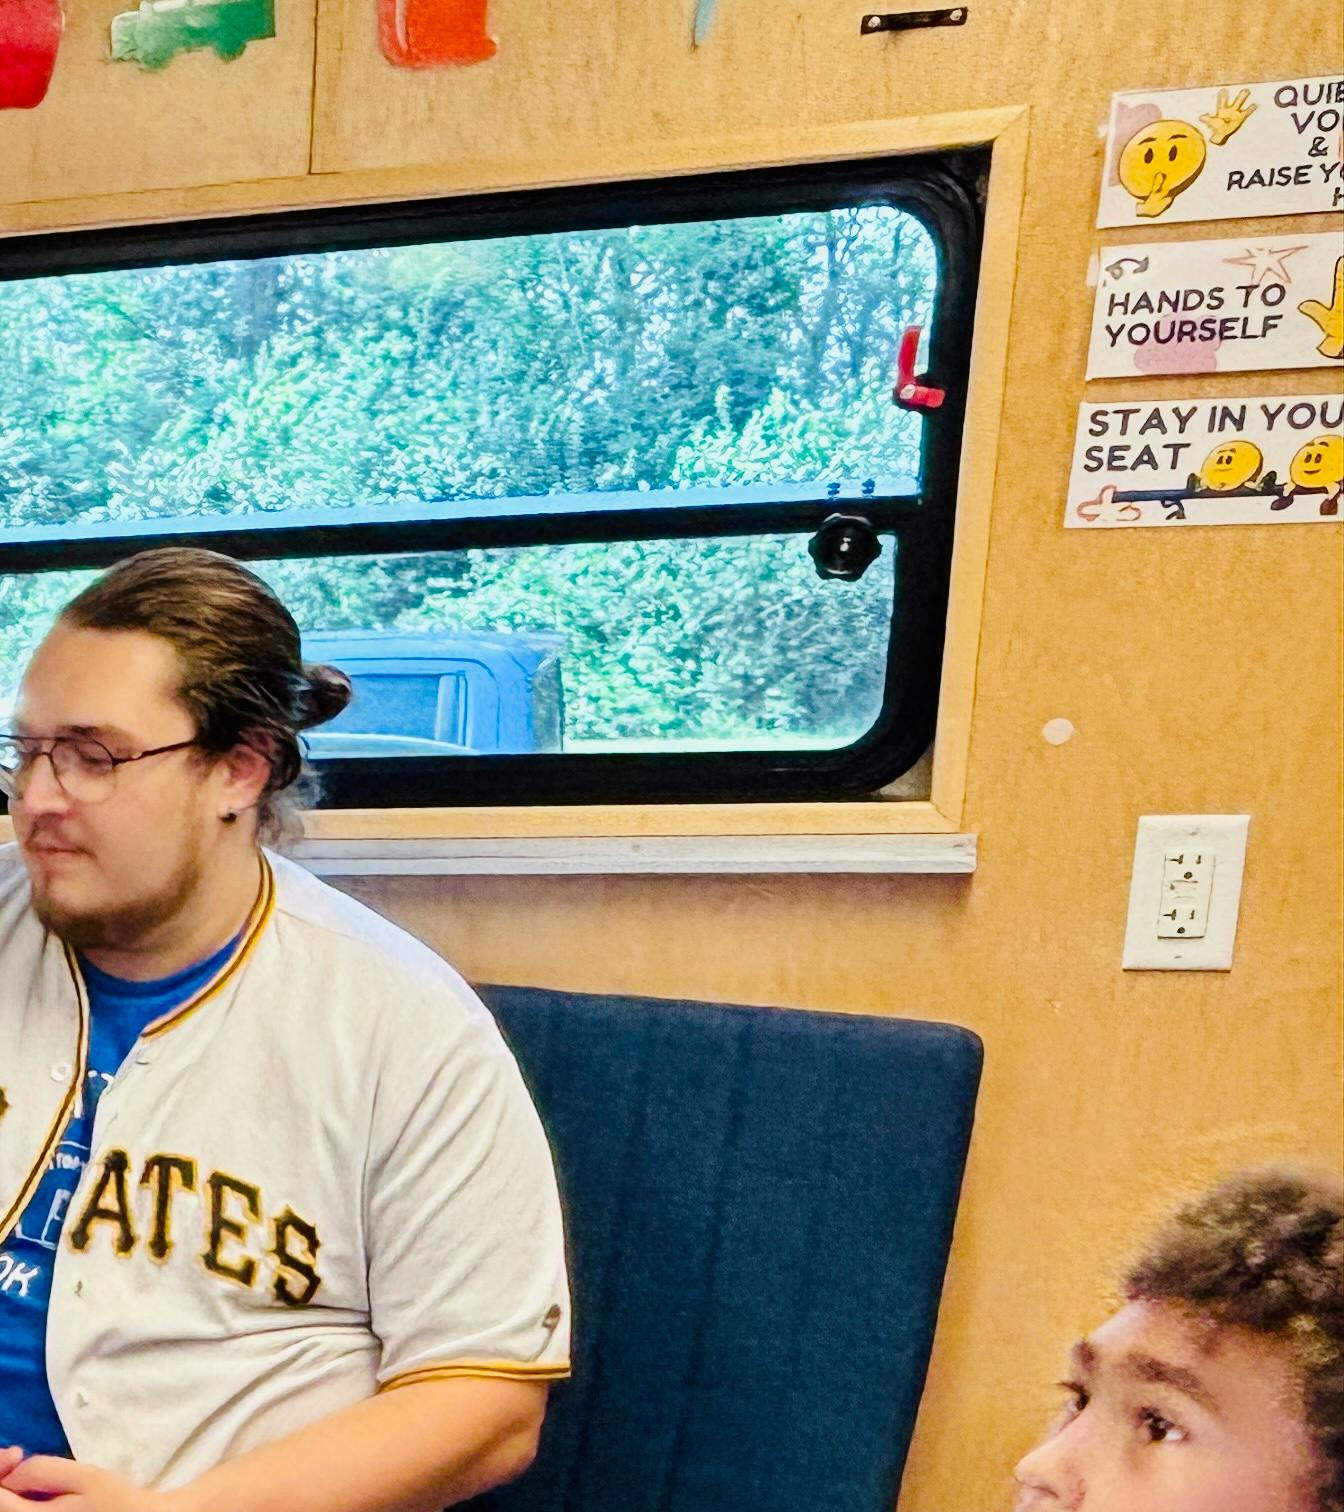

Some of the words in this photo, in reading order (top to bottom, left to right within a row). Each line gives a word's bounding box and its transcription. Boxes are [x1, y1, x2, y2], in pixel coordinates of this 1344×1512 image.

[1290, 108, 1344, 135] VO
[1307, 135, 1329, 158] &
[1226, 164, 1314, 192] RAISE
[1107, 286, 1226, 317] HANDS
[1235, 282, 1287, 309] TO
[1105, 314, 1284, 349] YOURSELF
[1087, 405, 1198, 438] STAY
[1206, 404, 1248, 433] IN
[1259, 400, 1344, 432] YOU
[1083, 442, 1192, 473] SEAT
